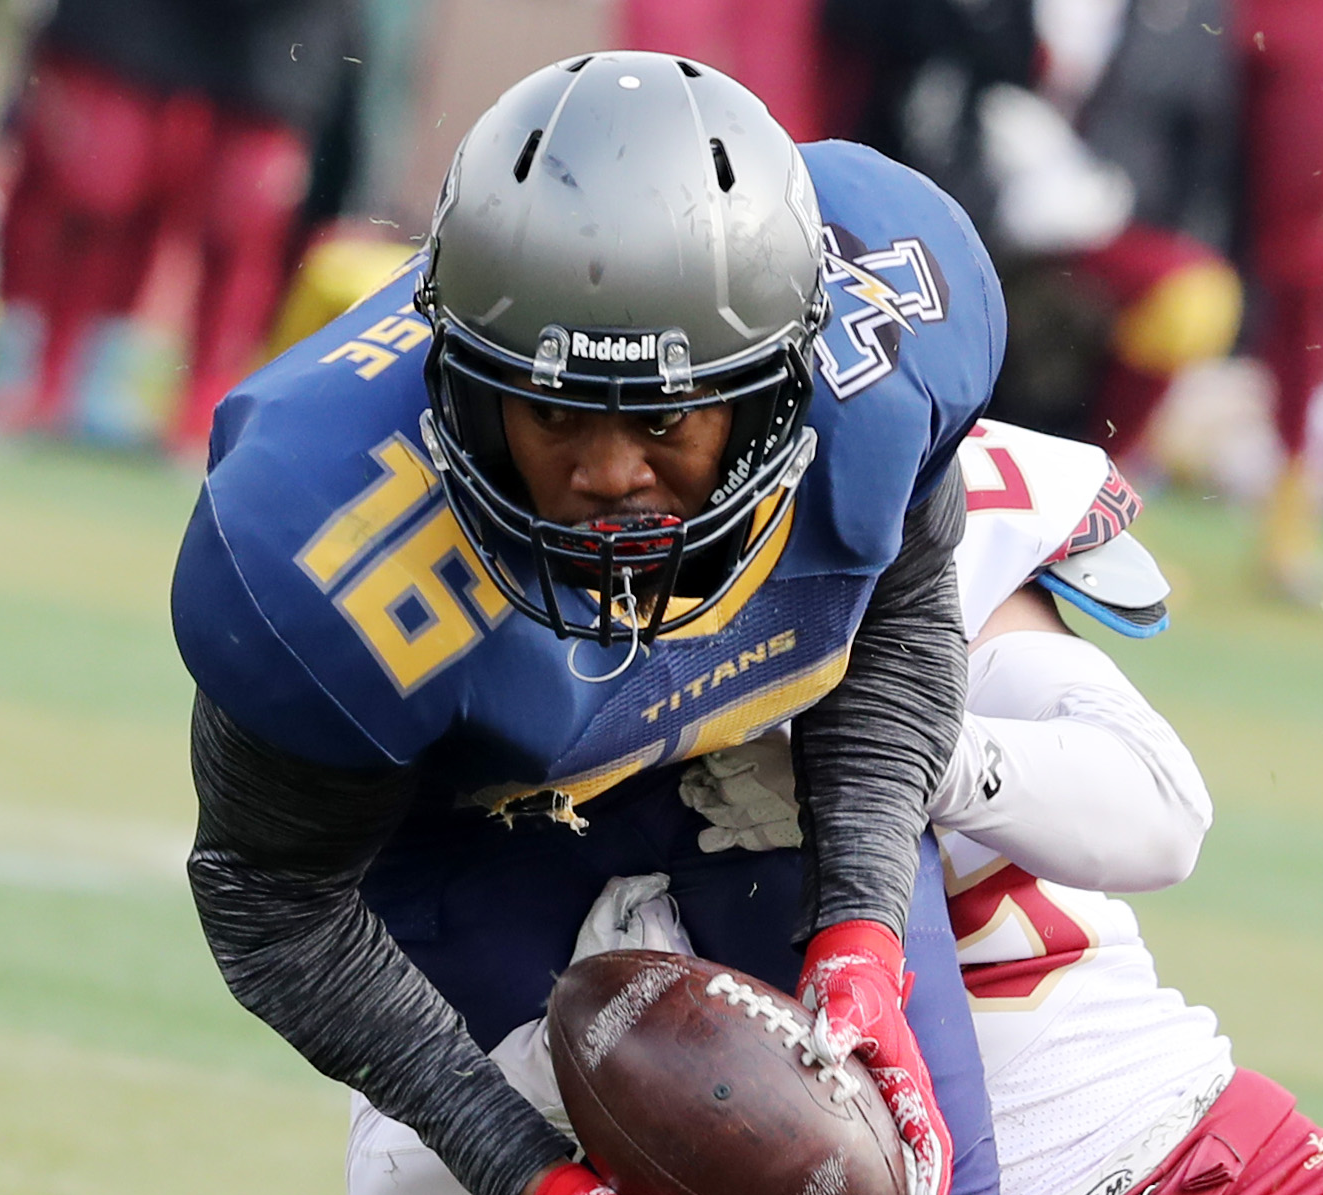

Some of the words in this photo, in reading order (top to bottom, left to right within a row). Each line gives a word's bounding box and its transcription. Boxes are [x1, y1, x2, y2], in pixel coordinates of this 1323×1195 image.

[318, 301, 433, 382] SE
[571, 331, 657, 362] Riddell
[292, 430, 526, 700] 16
[641, 628, 797, 723] TITANS
